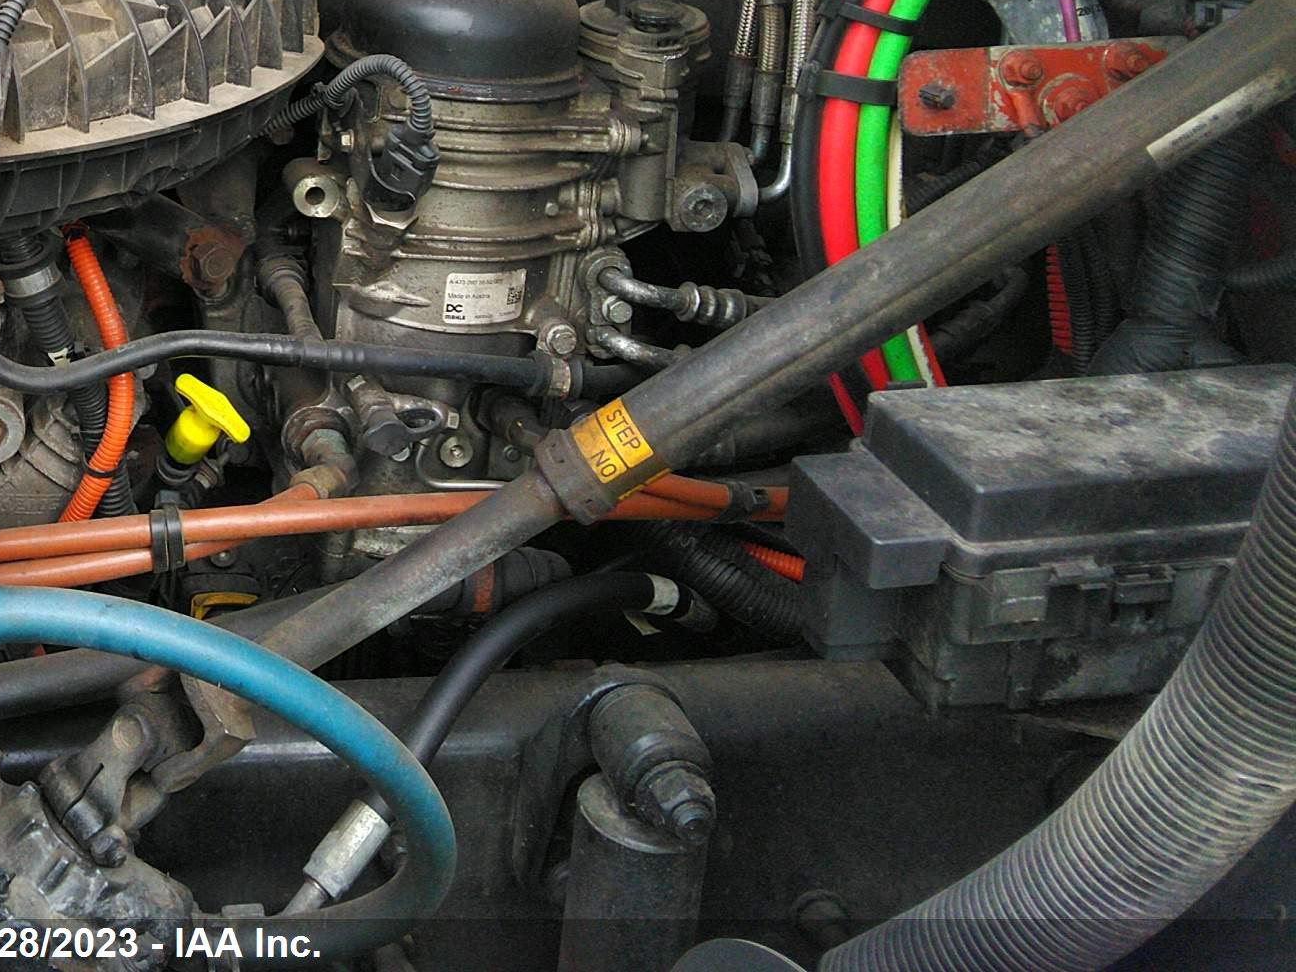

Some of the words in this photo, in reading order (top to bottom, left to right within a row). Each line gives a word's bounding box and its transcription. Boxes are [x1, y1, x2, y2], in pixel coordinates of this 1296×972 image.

[446, 303, 463, 313] DC
[606, 409, 641, 449] STEP
[591, 449, 617, 478] NO
